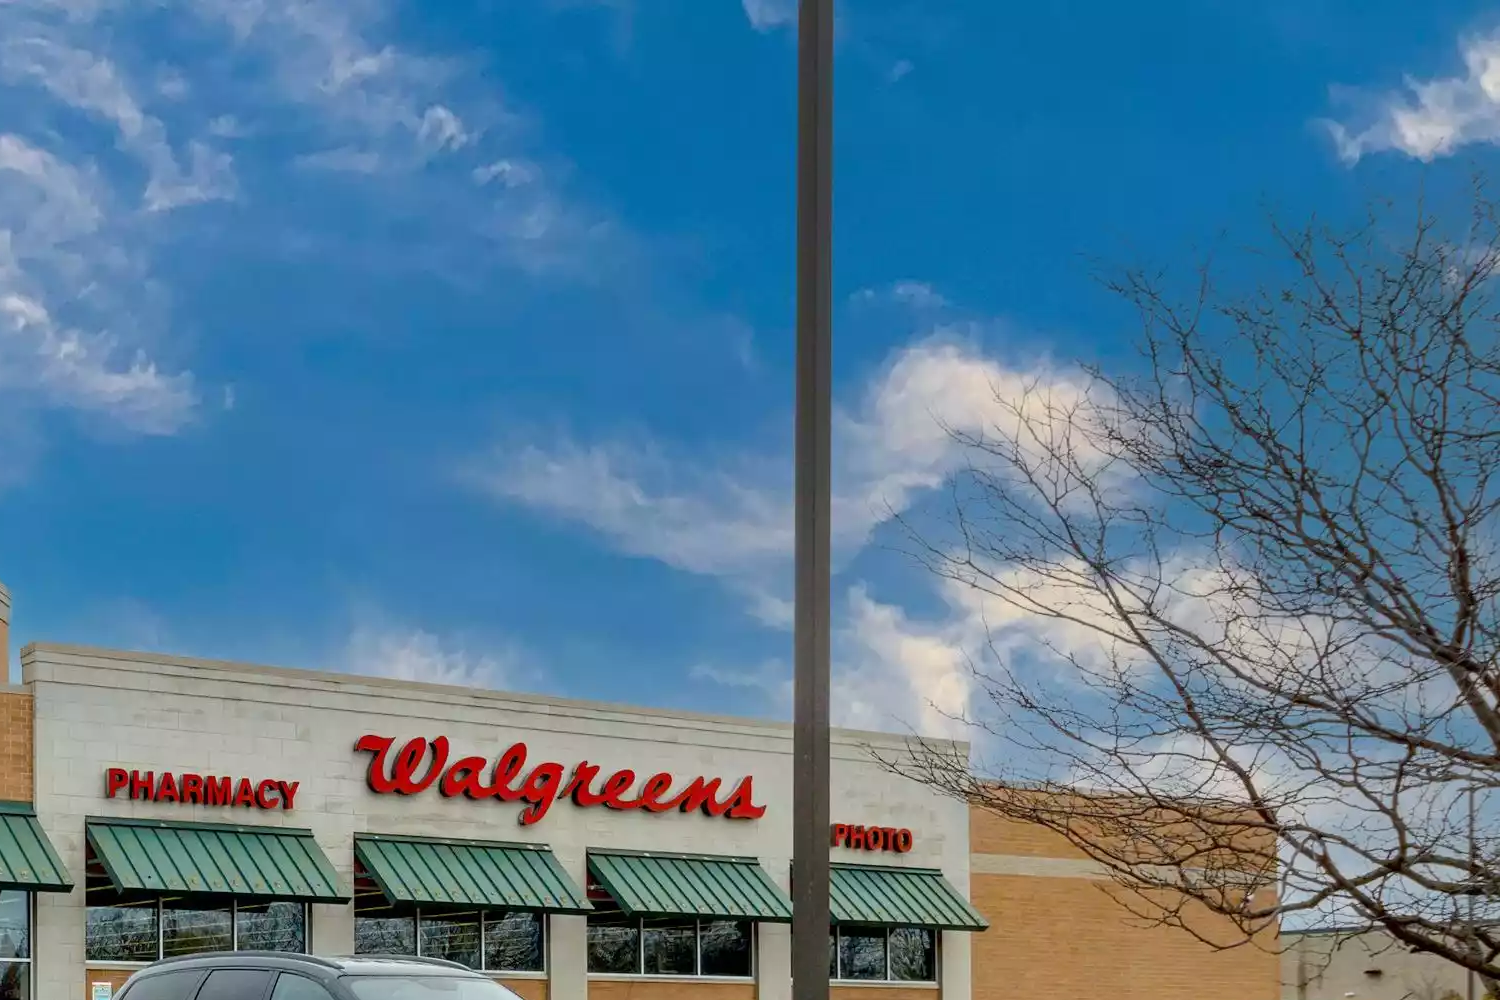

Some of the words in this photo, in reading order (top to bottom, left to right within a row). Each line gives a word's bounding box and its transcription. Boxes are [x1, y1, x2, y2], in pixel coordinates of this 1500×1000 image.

[106, 767, 299, 810] PHARMACY
[354, 734, 767, 826] Walgreens
[831, 824, 913, 853] PHOTO
